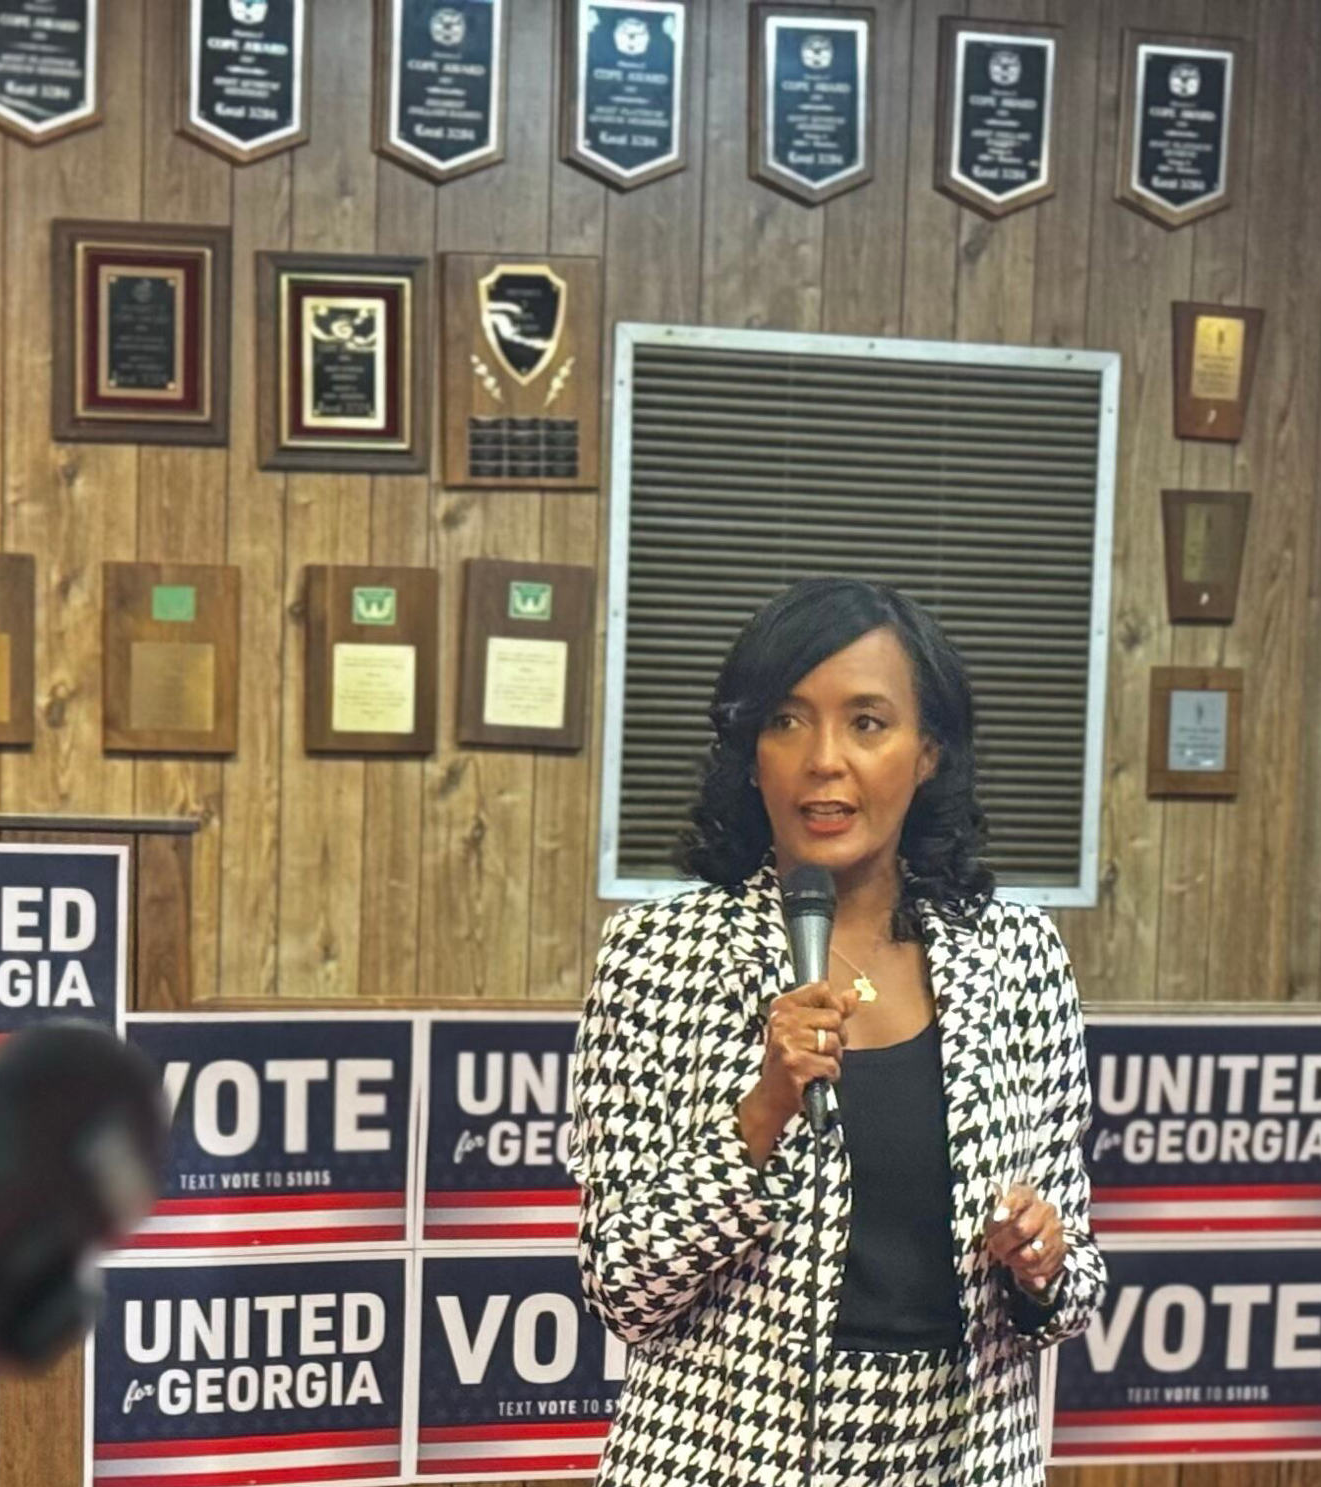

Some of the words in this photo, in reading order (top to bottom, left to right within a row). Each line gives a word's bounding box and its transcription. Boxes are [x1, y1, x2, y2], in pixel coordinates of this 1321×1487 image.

[458, 1052, 577, 1116] UNI
[1092, 1128, 1122, 1162] for
[180, 1173, 215, 1190] TEXT
[221, 1171, 261, 1189] VOTE
[264, 1171, 282, 1188] TO
[286, 1169, 332, 1187] 51015
[124, 1292, 386, 1364] UNITED
[122, 1378, 156, 1414] for
[157, 1359, 384, 1416] GEORGIA
[1164, 1386, 1201, 1402] VOTE
[1206, 1386, 1222, 1401] TO
[1226, 1384, 1269, 1401] 51015
[498, 1400, 533, 1416] TEXT
[537, 1399, 577, 1415] VOTE
[582, 1398, 599, 1413] TO
